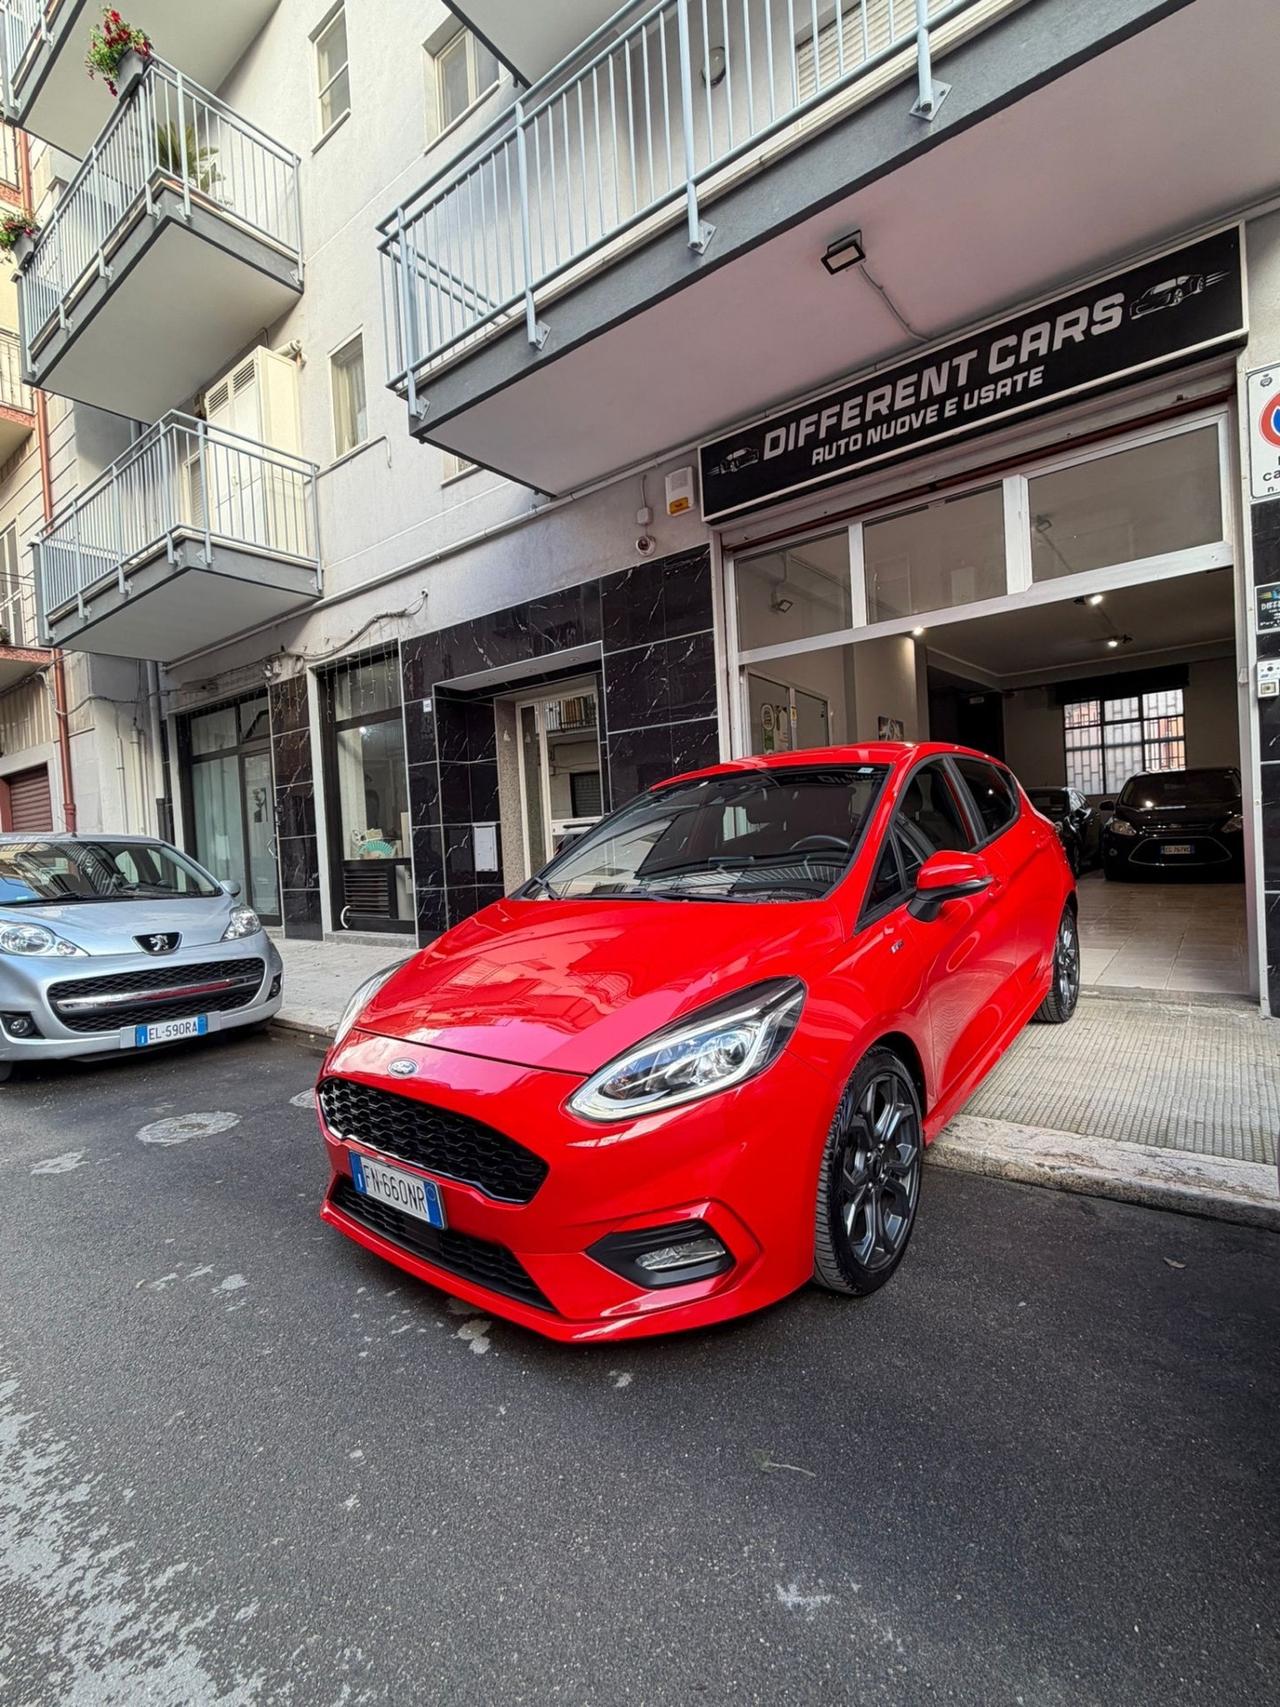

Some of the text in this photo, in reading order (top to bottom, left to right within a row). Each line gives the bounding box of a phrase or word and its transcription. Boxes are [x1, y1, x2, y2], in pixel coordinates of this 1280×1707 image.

[763, 293, 1125, 460] DIFFERENT CARS
[811, 365, 1045, 466] AUTO NUOVE E USATE
